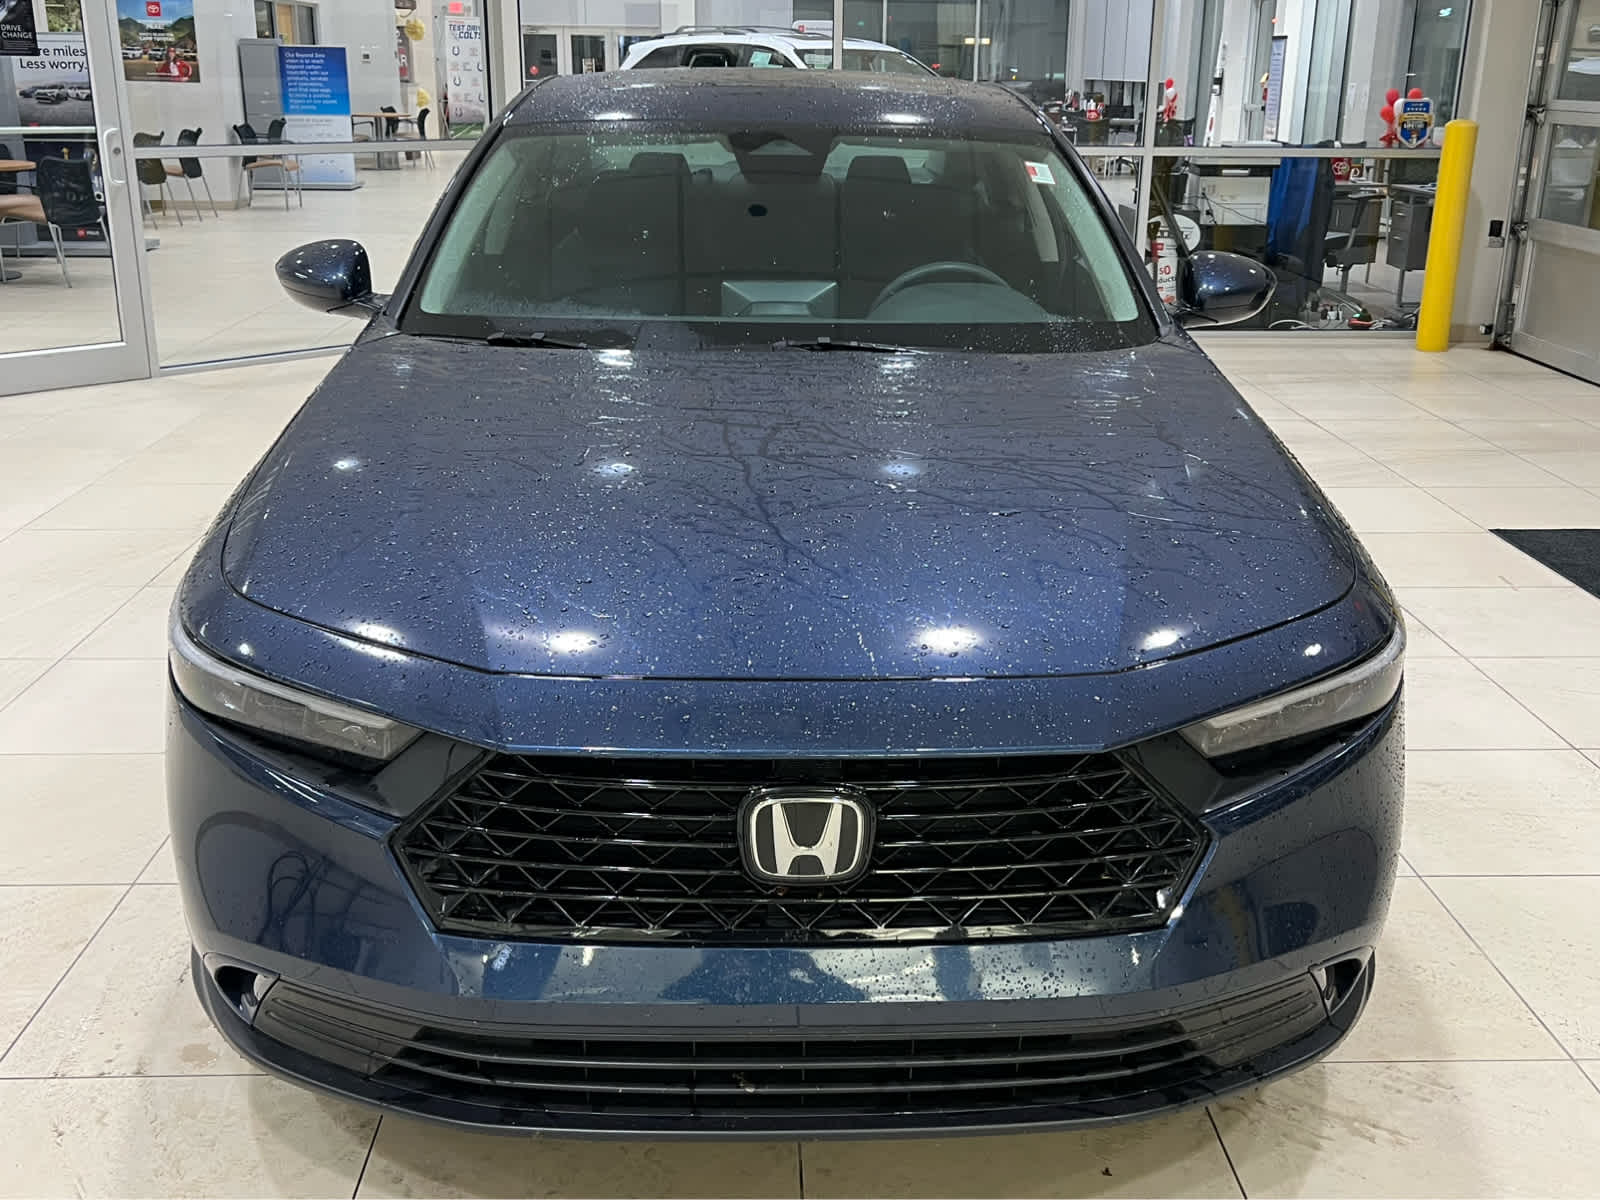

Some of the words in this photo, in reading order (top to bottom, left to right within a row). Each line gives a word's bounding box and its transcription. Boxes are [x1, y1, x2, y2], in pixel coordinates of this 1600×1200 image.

[448, 24, 465, 32] TEST
[1, 31, 33, 39] CHANGE
[53, 45, 87, 57] miles
[20, 58, 46, 69] Less
[48, 61, 88, 72] worry.
